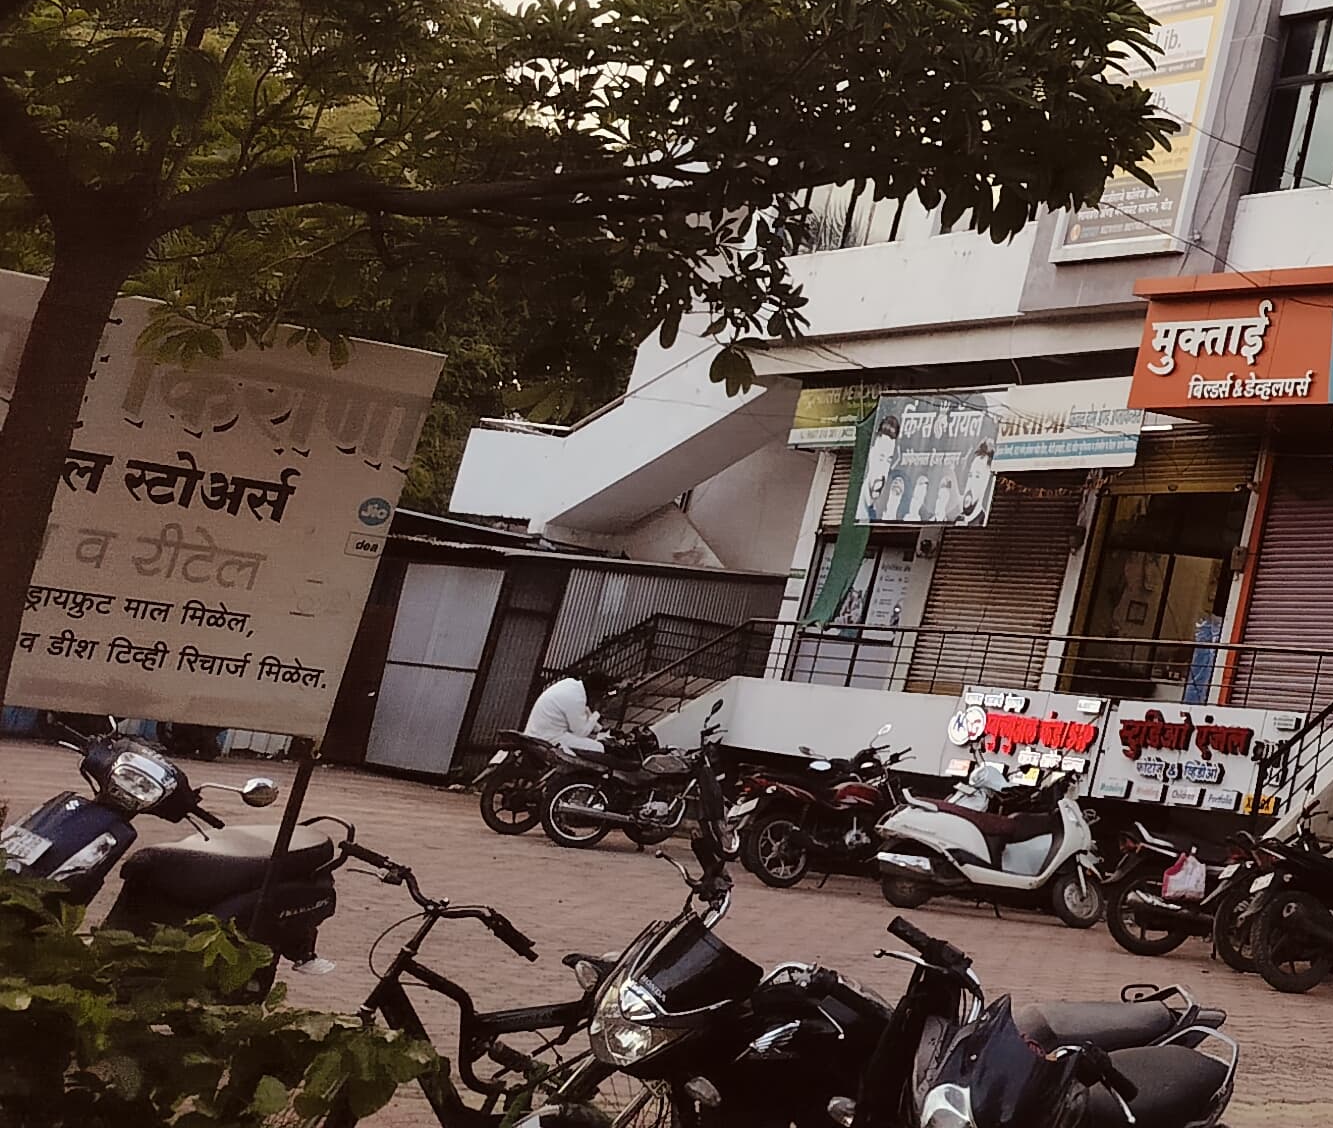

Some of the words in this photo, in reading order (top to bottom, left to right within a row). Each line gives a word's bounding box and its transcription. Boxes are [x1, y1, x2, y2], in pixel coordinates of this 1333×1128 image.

[1147, 299, 1273, 375] मुक्ताई
[1187, 372, 1234, 399] बिल्डर्स
[1243, 370, 1313, 400] डेव्हलपर्स
[124, 451, 301, 524] स्टोअर्स
[132, 522, 267, 591] रीटेल
[124, 598, 174, 623] माल
[180, 599, 254, 638] मिळेल,
[47, 630, 99, 660] डीश
[106, 637, 170, 671] टिव्ही
[177, 645, 252, 678] रिचार्ज
[257, 655, 327, 689] मिळेल.
[1119, 709, 1195, 760] स्टुडिओ
